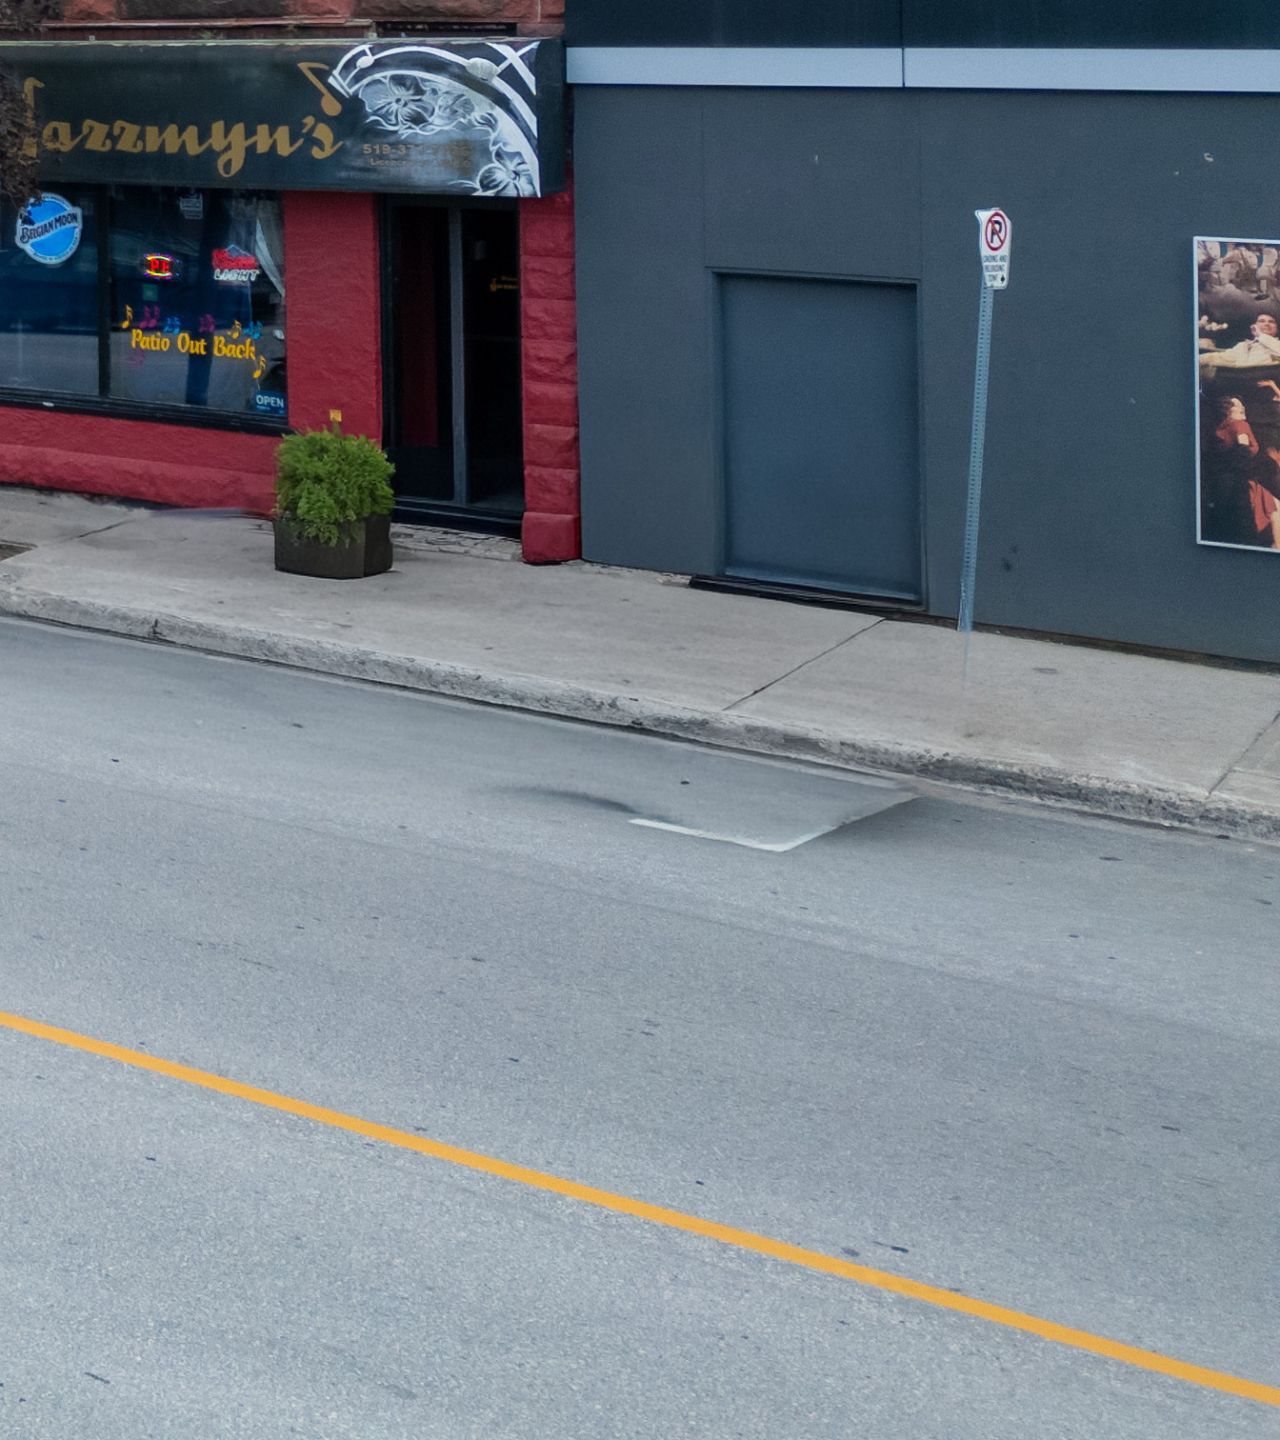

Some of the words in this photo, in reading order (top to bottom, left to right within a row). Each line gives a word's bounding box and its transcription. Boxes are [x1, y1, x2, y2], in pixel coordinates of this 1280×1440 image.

[131, 329, 171, 352] Patio
[177, 332, 207, 356] Out
[212, 335, 256, 360] Back
[255, 394, 285, 408] OPEN
